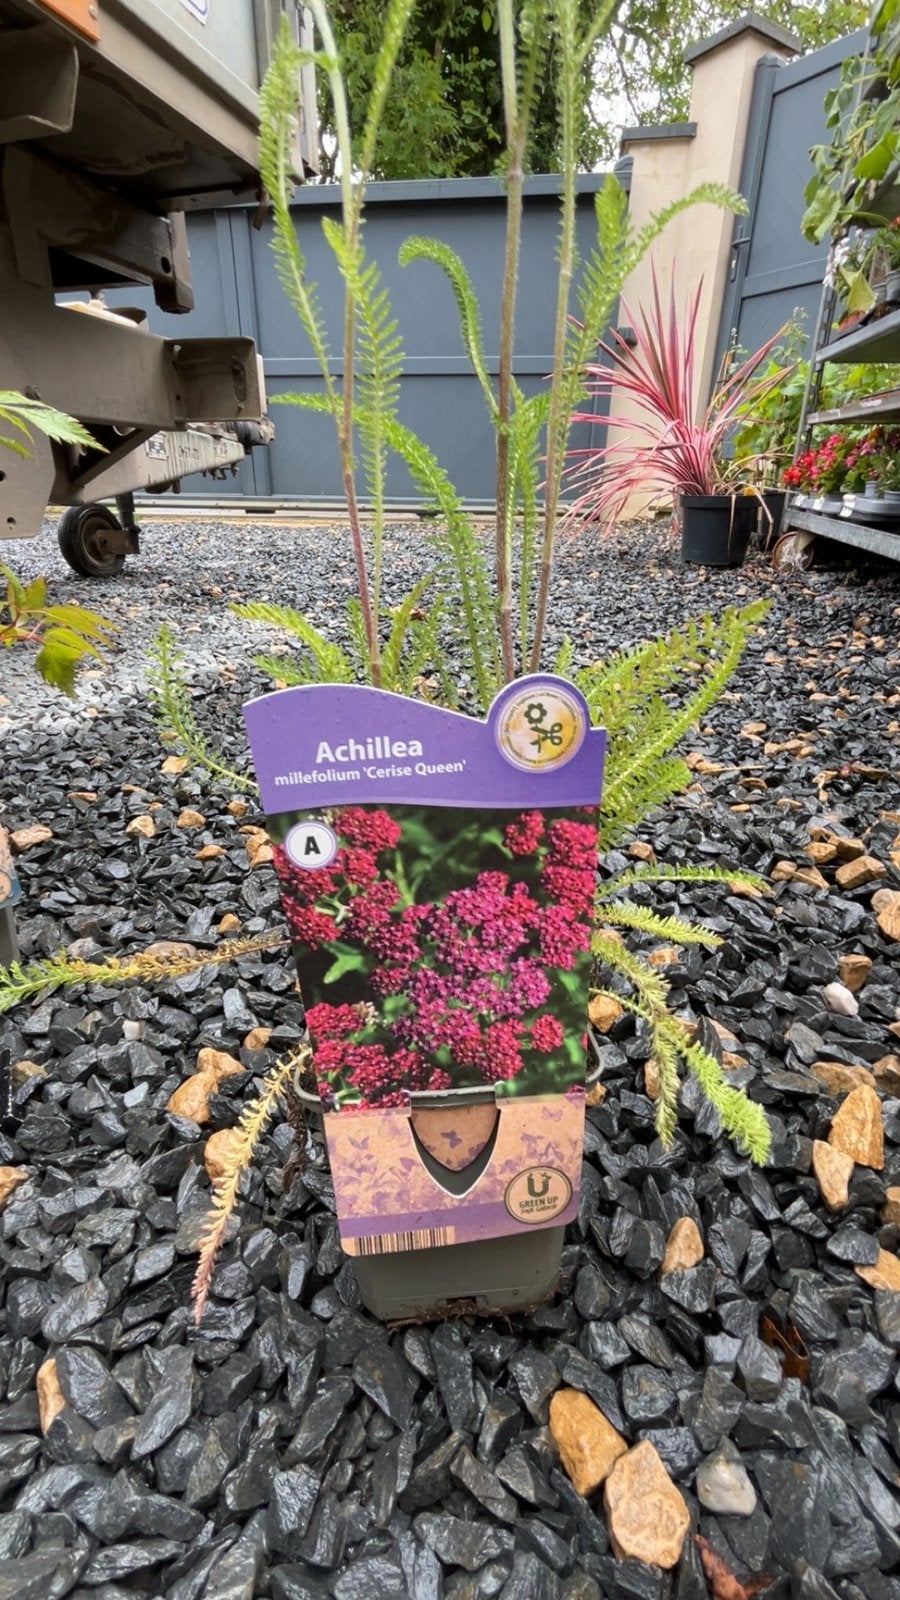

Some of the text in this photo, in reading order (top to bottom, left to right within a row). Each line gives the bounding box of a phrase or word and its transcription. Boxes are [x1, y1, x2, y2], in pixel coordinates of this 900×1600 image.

[315, 736, 424, 764] Achillea
[274, 759, 467, 786] millefolium 'Cerise Queen'
[304, 835, 321, 855] A
[519, 1196, 558, 1208] GREEN UP
